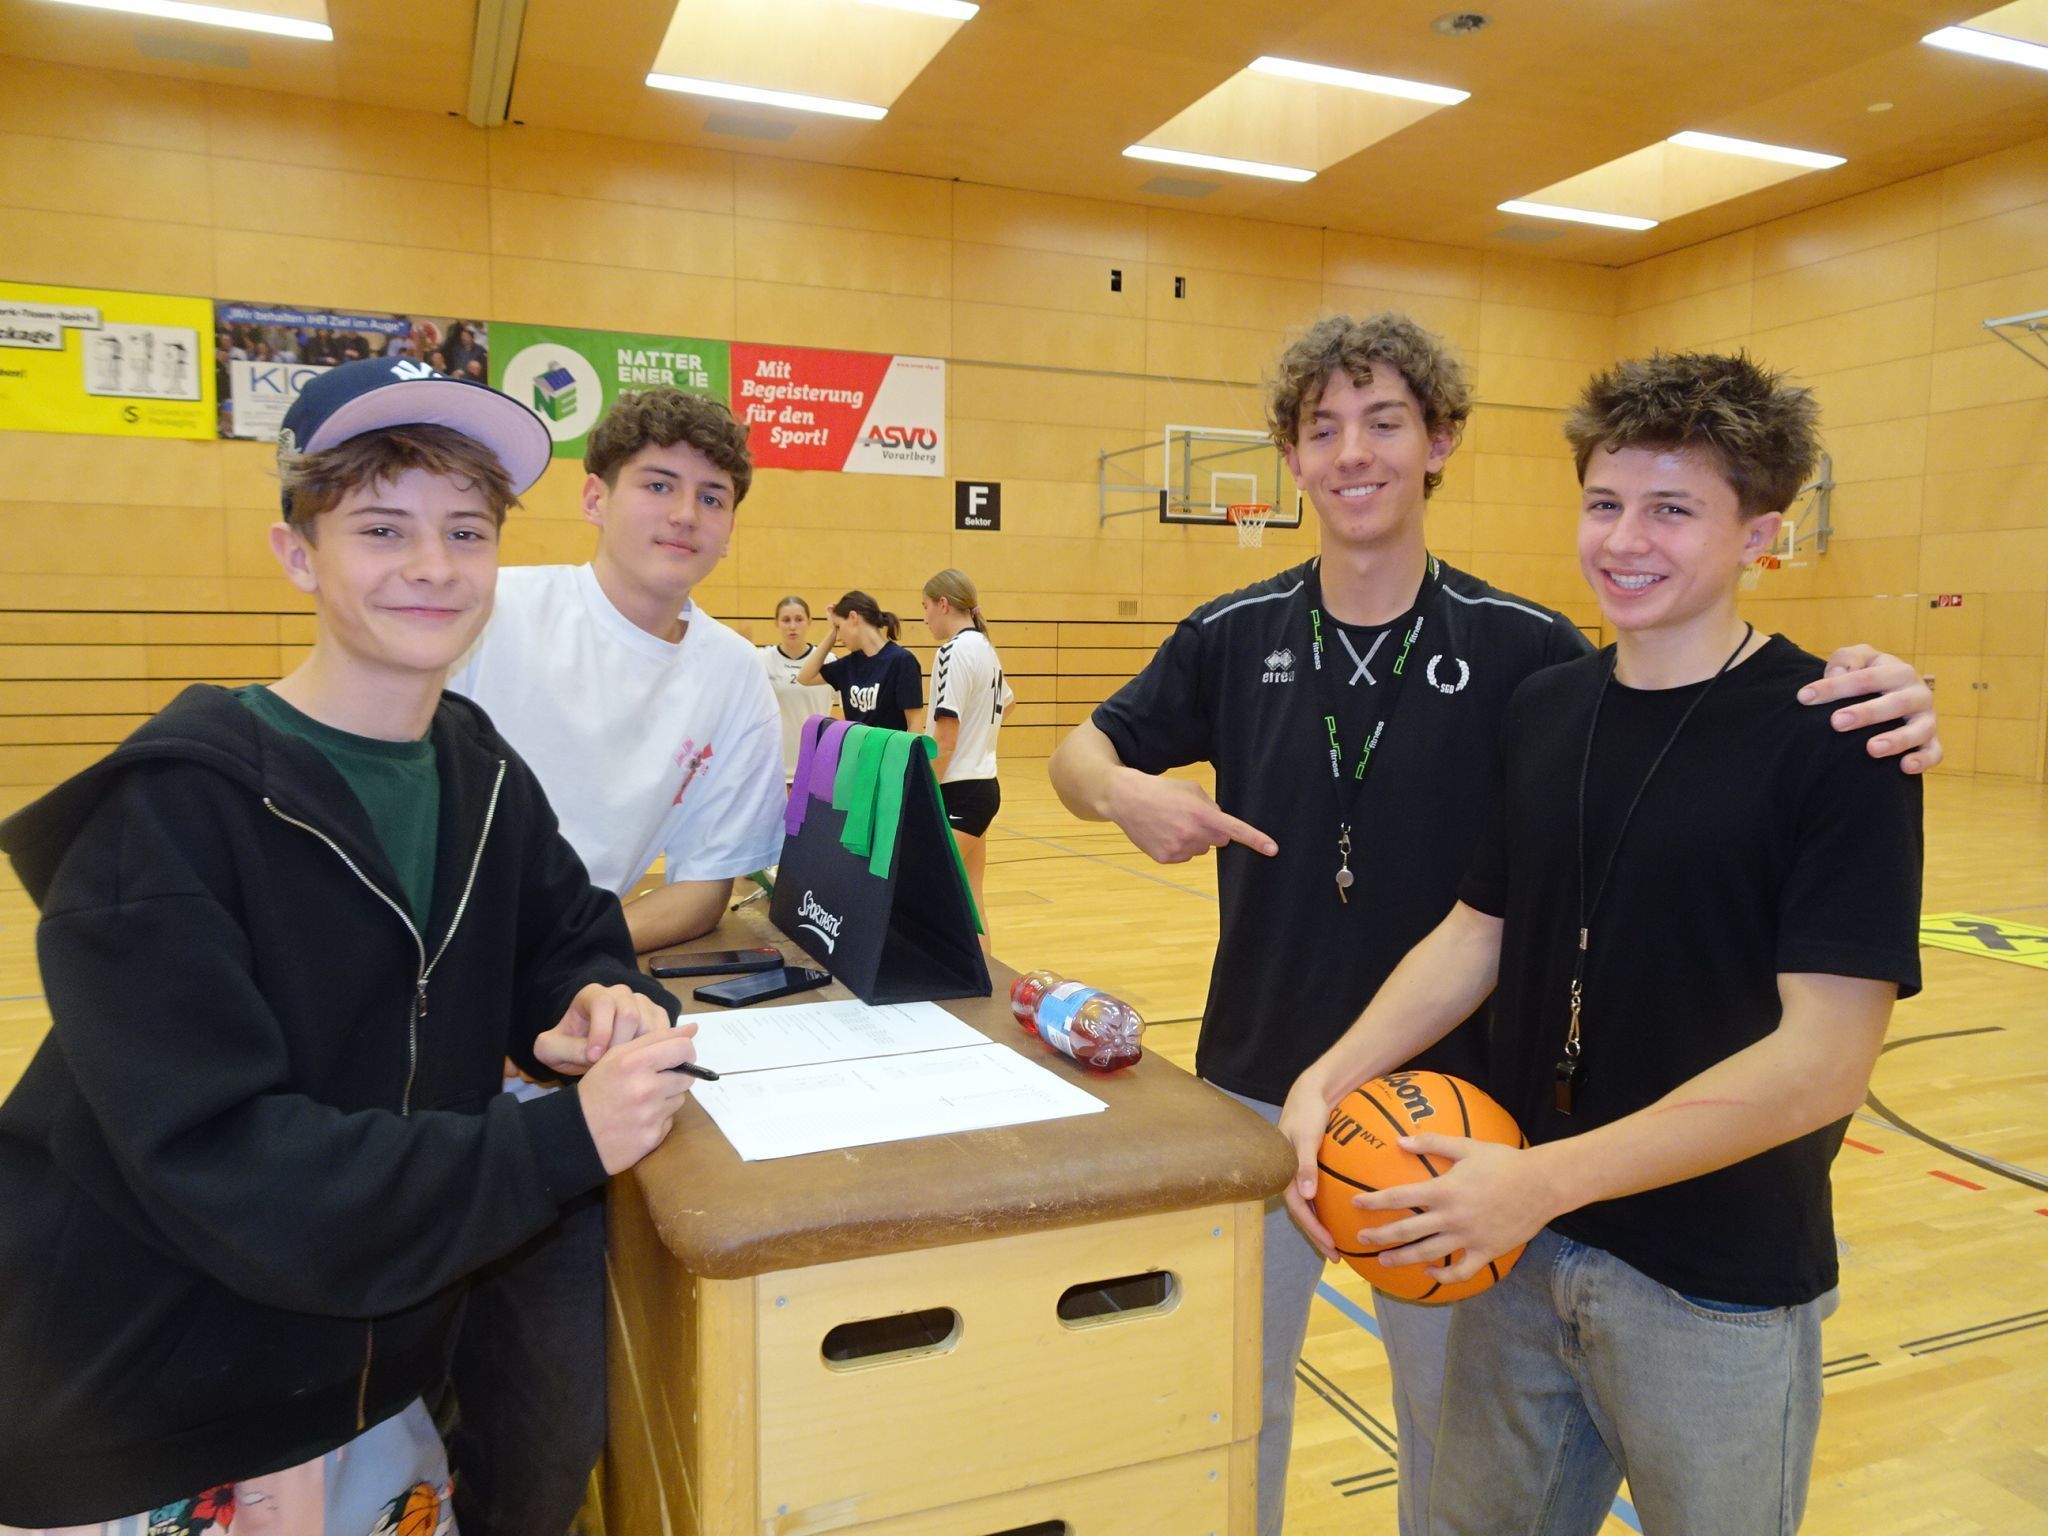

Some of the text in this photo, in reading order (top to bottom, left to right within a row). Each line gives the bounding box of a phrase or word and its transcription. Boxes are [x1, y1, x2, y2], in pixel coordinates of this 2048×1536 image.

[617, 349, 703, 371] NATTER
[755, 360, 792, 379] Mit
[741, 379, 864, 409] Begeisterung
[744, 403, 815, 425] für den
[770, 426, 829, 449] Sport!
[882, 450, 936, 464] Vorarlberg
[969, 486, 989, 515] F
[964, 517, 991, 526] Sektor
[1382, 1072, 1436, 1123] lson
[1360, 1130, 1387, 1149] NXT
